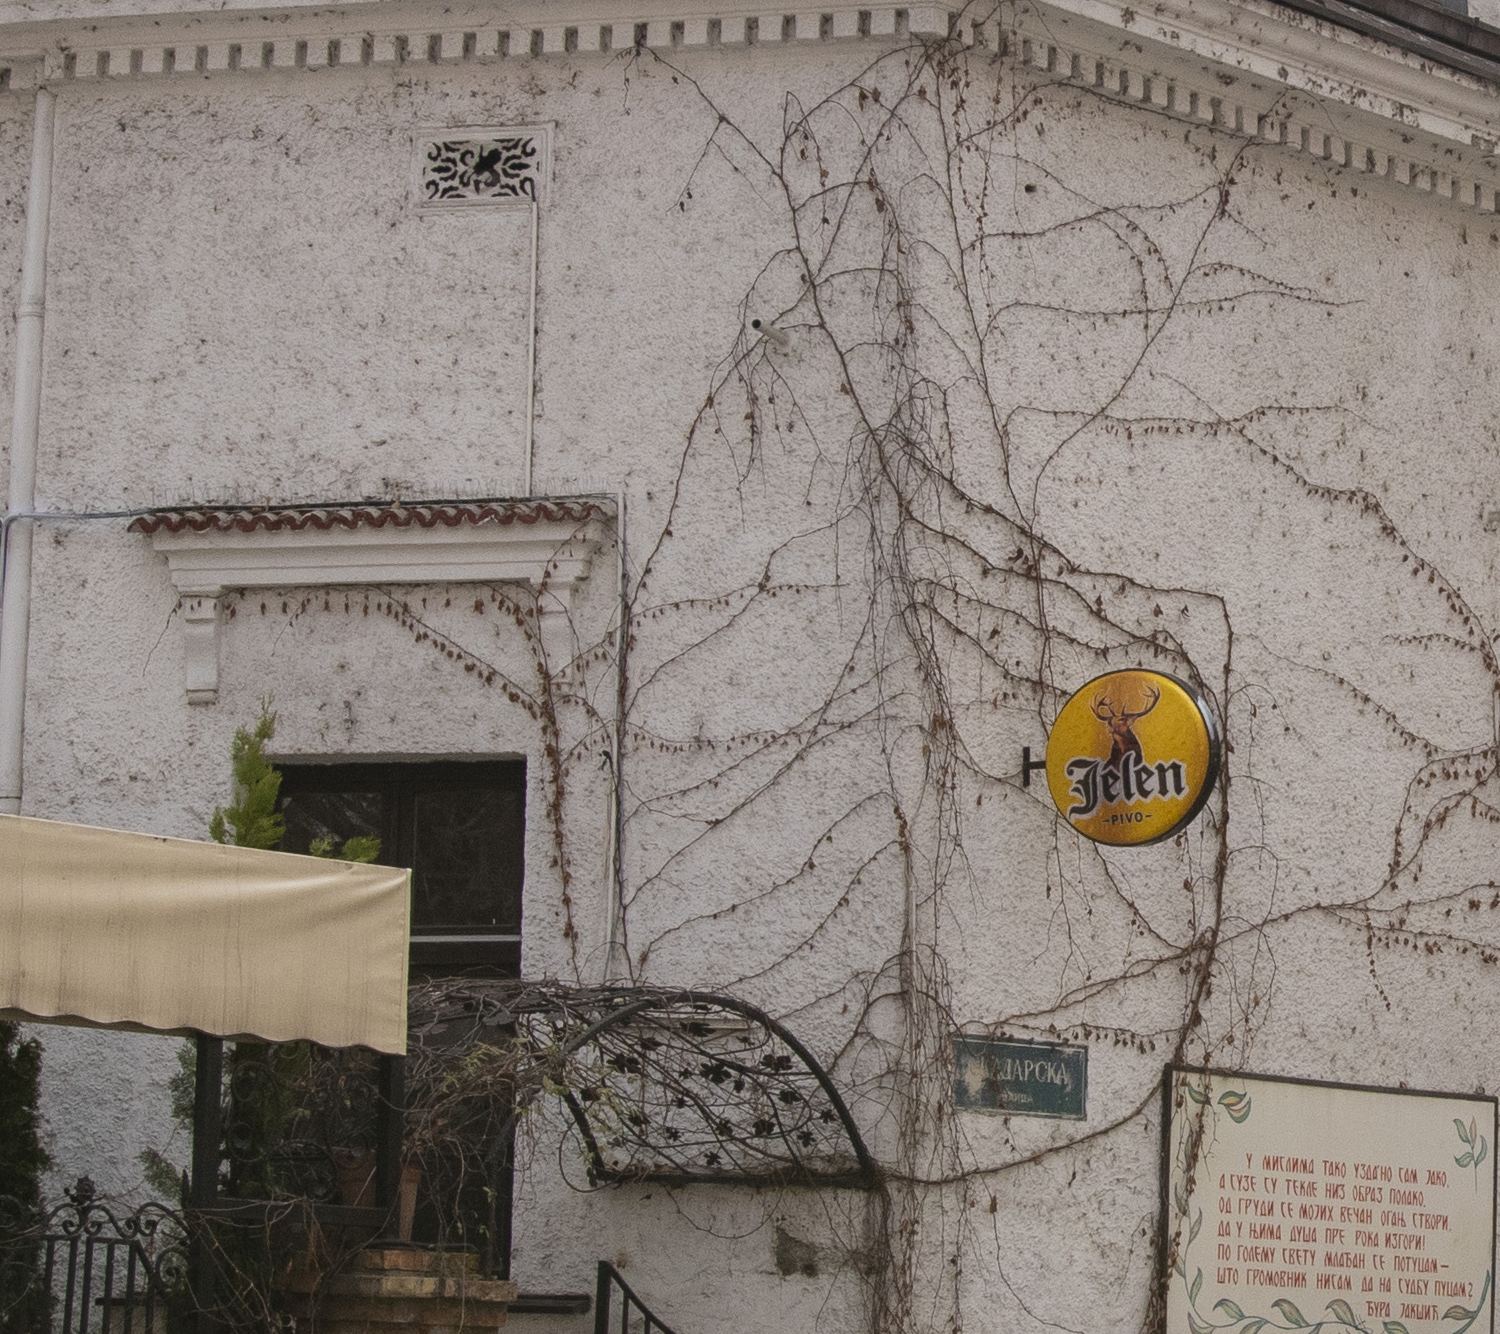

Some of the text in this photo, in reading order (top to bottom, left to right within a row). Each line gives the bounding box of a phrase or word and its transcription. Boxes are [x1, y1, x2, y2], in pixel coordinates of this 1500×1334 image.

[1066, 751, 1185, 819] Jelen
[1262, 1155, 1314, 1174] МИСЛИМА
[1323, 1160, 1347, 1178] ТАКО
[1398, 1167, 1418, 1185] САМ
[1230, 1174, 1256, 1192] СУЗЕ
[1264, 1177, 1277, 1194] СУ
[1285, 1179, 1317, 1197] ТЕКЛЕ
[1325, 1182, 1346, 1200] НИЗ
[1352, 1184, 1383, 1203] ОБРАЗ
[1219, 1196, 1232, 1214] ОД
[1238, 1198, 1274, 1217] ГРУДИ
[1280, 1201, 1293, 1218] СЕ
[1299, 1203, 1334, 1222] МОЈИХ
[1340, 1206, 1373, 1225] ВЕЧАН
[1381, 1210, 1407, 1228] ОГАЊ
[1218, 1220, 1231, 1237] ДА
[1249, 1222, 1282, 1240] ЊИМА
[1289, 1225, 1317, 1243] ДУША
[1325, 1228, 1345, 1245] ПРЕ
[1355, 1230, 1379, 1248] РОКА
[1385, 1233, 1426, 1251] ИЗГОРИ!
[1217, 1243, 1231, 1261] ПО
[1237, 1244, 1276, 1263] ГОЛЕМУ
[1282, 1248, 1316, 1266] СВЕТУ
[1324, 1250, 1366, 1269] МЛАЂАН
[1373, 1254, 1386, 1270] СЕ
[1394, 1255, 1438, 1274] ПОТУЦАМ
[1217, 1267, 1239, 1285] ШТО
[1246, 1268, 1307, 1289] ГРОМОВНИК
[1316, 1272, 1352, 1291] НИСАМ
[1361, 1276, 1373, 1293] ДА
[1379, 1277, 1391, 1293] НА
[1398, 1278, 1429, 1296] СУДБУ
[1366, 1301, 1439, 1320] ЂУРА ЈАКШИЋ
